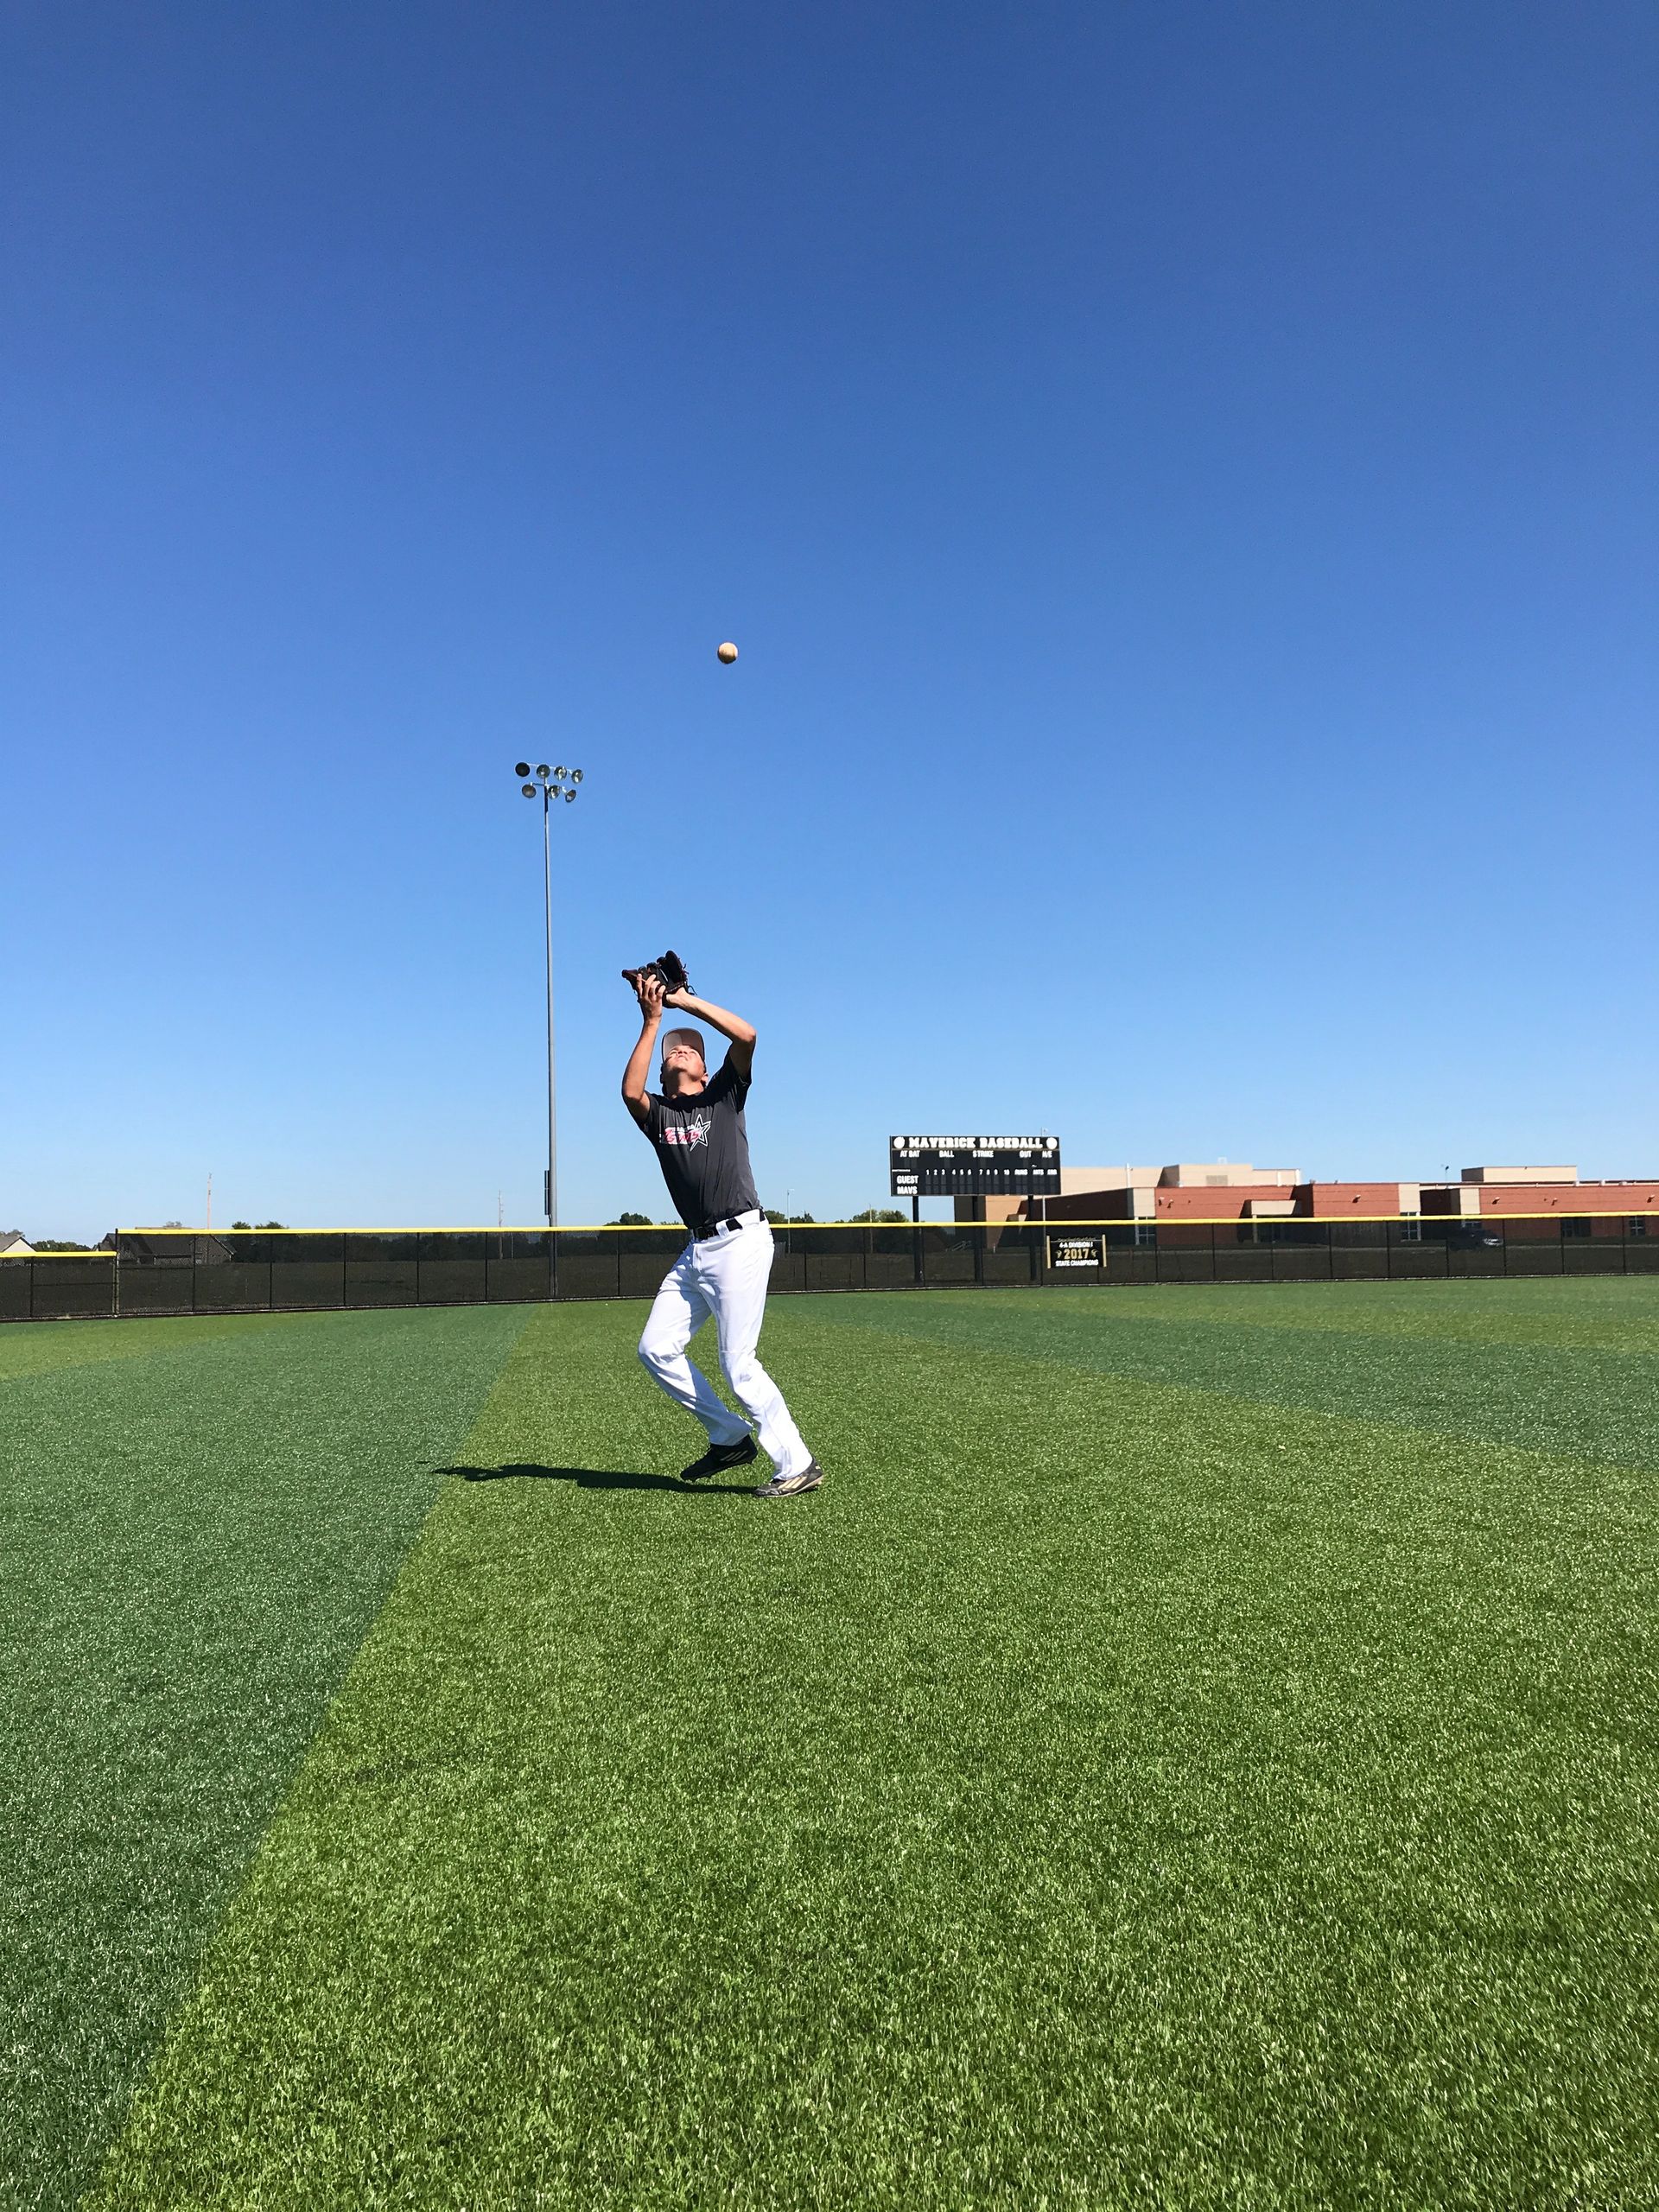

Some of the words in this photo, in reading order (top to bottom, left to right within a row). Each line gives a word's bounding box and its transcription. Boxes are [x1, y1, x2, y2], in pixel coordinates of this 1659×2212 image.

[909, 1137, 976, 1148] MAVERICK
[980, 1137, 1043, 1148] BASEBALL
[897, 1175, 918, 1184] GUEST
[1064, 1249, 1090, 1259] 2017
